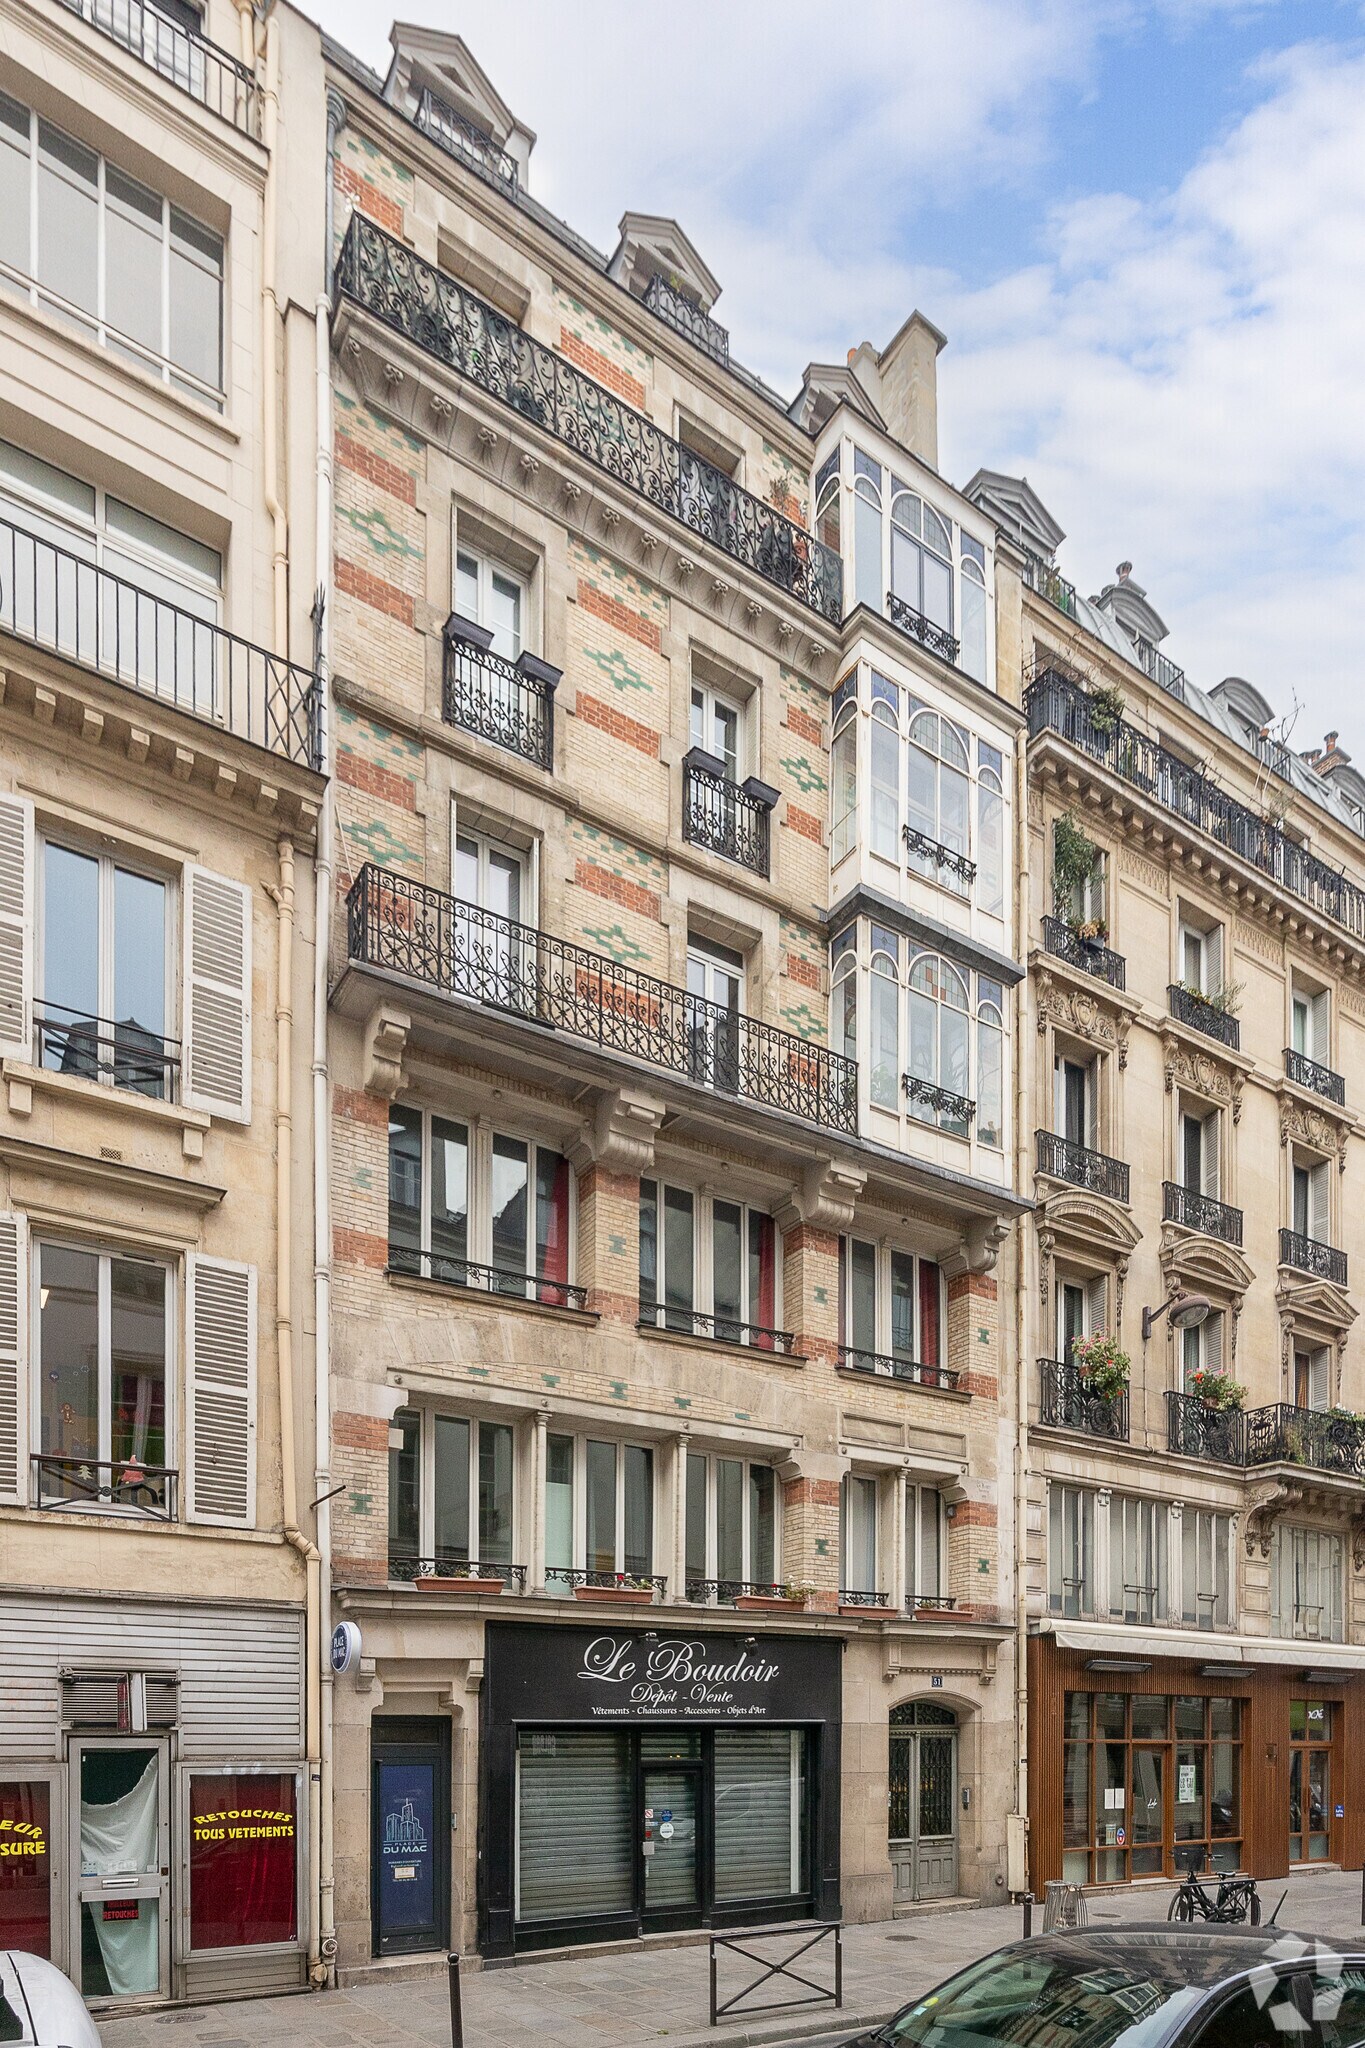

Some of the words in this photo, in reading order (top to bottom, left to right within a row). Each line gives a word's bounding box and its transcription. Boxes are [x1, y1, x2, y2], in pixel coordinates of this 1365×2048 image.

[577, 1636, 637, 1683] Le
[646, 1640, 780, 1682] Boudoir
[933, 1677, 941, 1686] 51
[629, 1682, 678, 1708] Dépôt
[690, 1681, 734, 1704] Vente
[591, 1706, 630, 1715] Vêtements
[636, 1704, 678, 1715] Chaussures
[684, 1706, 721, 1715] Accessoires
[726, 1704, 747, 1718] Objets
[193, 1809, 294, 1825] RETOUCHES
[193, 1828, 226, 1840] TOUS
[228, 1825, 294, 1839] VETEMENTS
[0, 1841, 46, 1856] SURE
[383, 1846, 400, 1854] DU
[401, 1845, 428, 1853] MAC
[103, 1909, 139, 1920] RETOUCHES
